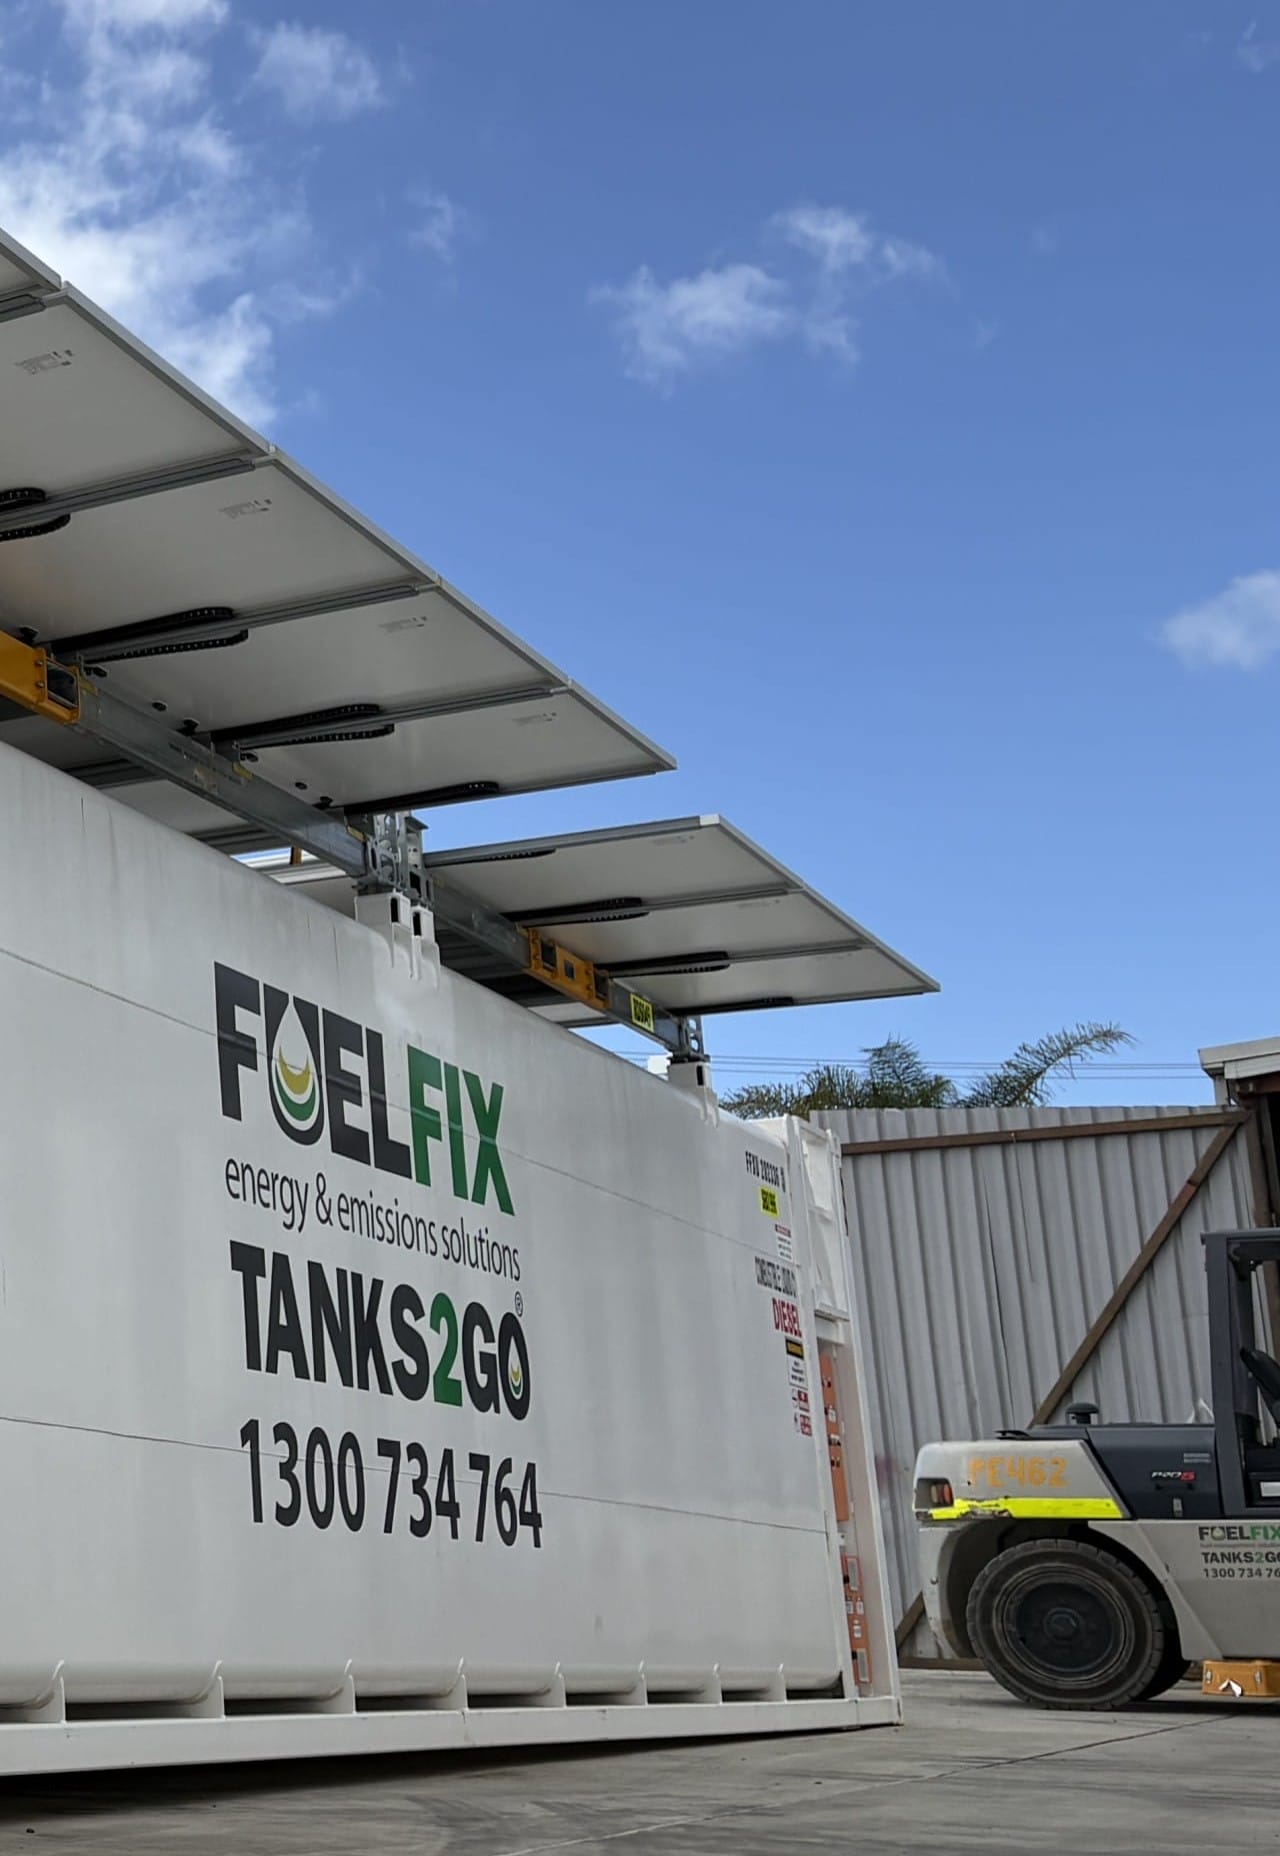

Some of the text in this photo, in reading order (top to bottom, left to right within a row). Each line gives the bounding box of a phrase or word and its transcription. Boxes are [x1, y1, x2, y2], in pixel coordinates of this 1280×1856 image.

[214, 960, 515, 1217] FUELFIX
[225, 1158, 520, 1282] energy & emissions solutions
[772, 1297, 802, 1338] DIESEL
[240, 1418, 542, 1548] 1300 734 764
[968, 1456, 1069, 1488] PE462
[1204, 1568, 1235, 1578] 1300
[1238, 1568, 1263, 1578] 734
